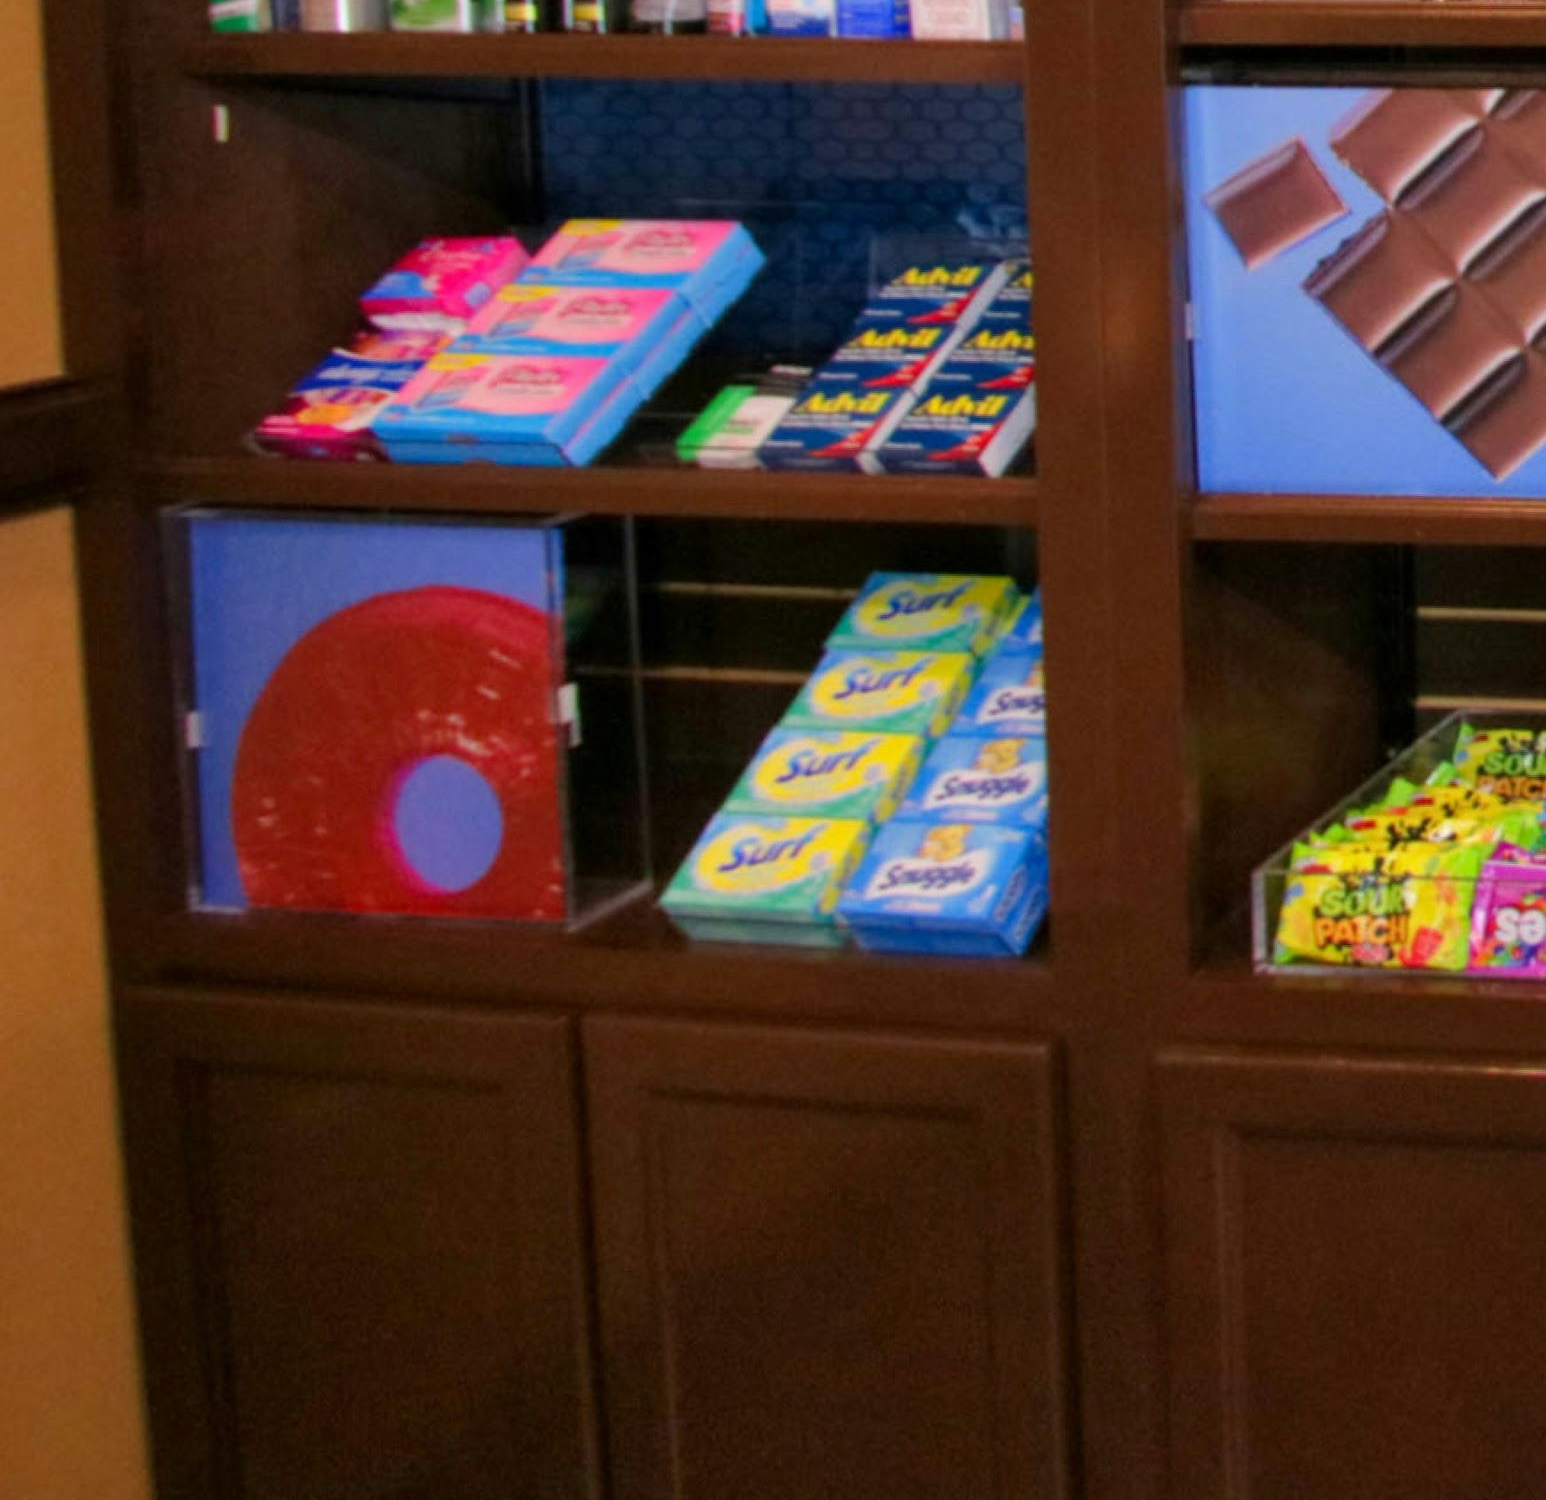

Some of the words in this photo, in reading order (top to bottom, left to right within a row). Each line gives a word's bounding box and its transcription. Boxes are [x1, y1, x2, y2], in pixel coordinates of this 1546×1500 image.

[849, 328, 941, 348] Advil
[962, 330, 1034, 349] Adv
[793, 392, 891, 413] Advil
[915, 395, 1008, 416] Advil
[877, 579, 975, 620] Surf
[833, 657, 934, 700] Surf
[989, 692, 1046, 714] Snug
[775, 738, 882, 784] Surf
[936, 774, 1031, 799] Snuggle
[718, 824, 827, 872] Surf
[878, 863, 975, 889] Snuggle
[1319, 885, 1406, 917] SOUR
[1314, 916, 1409, 949] PATCH
